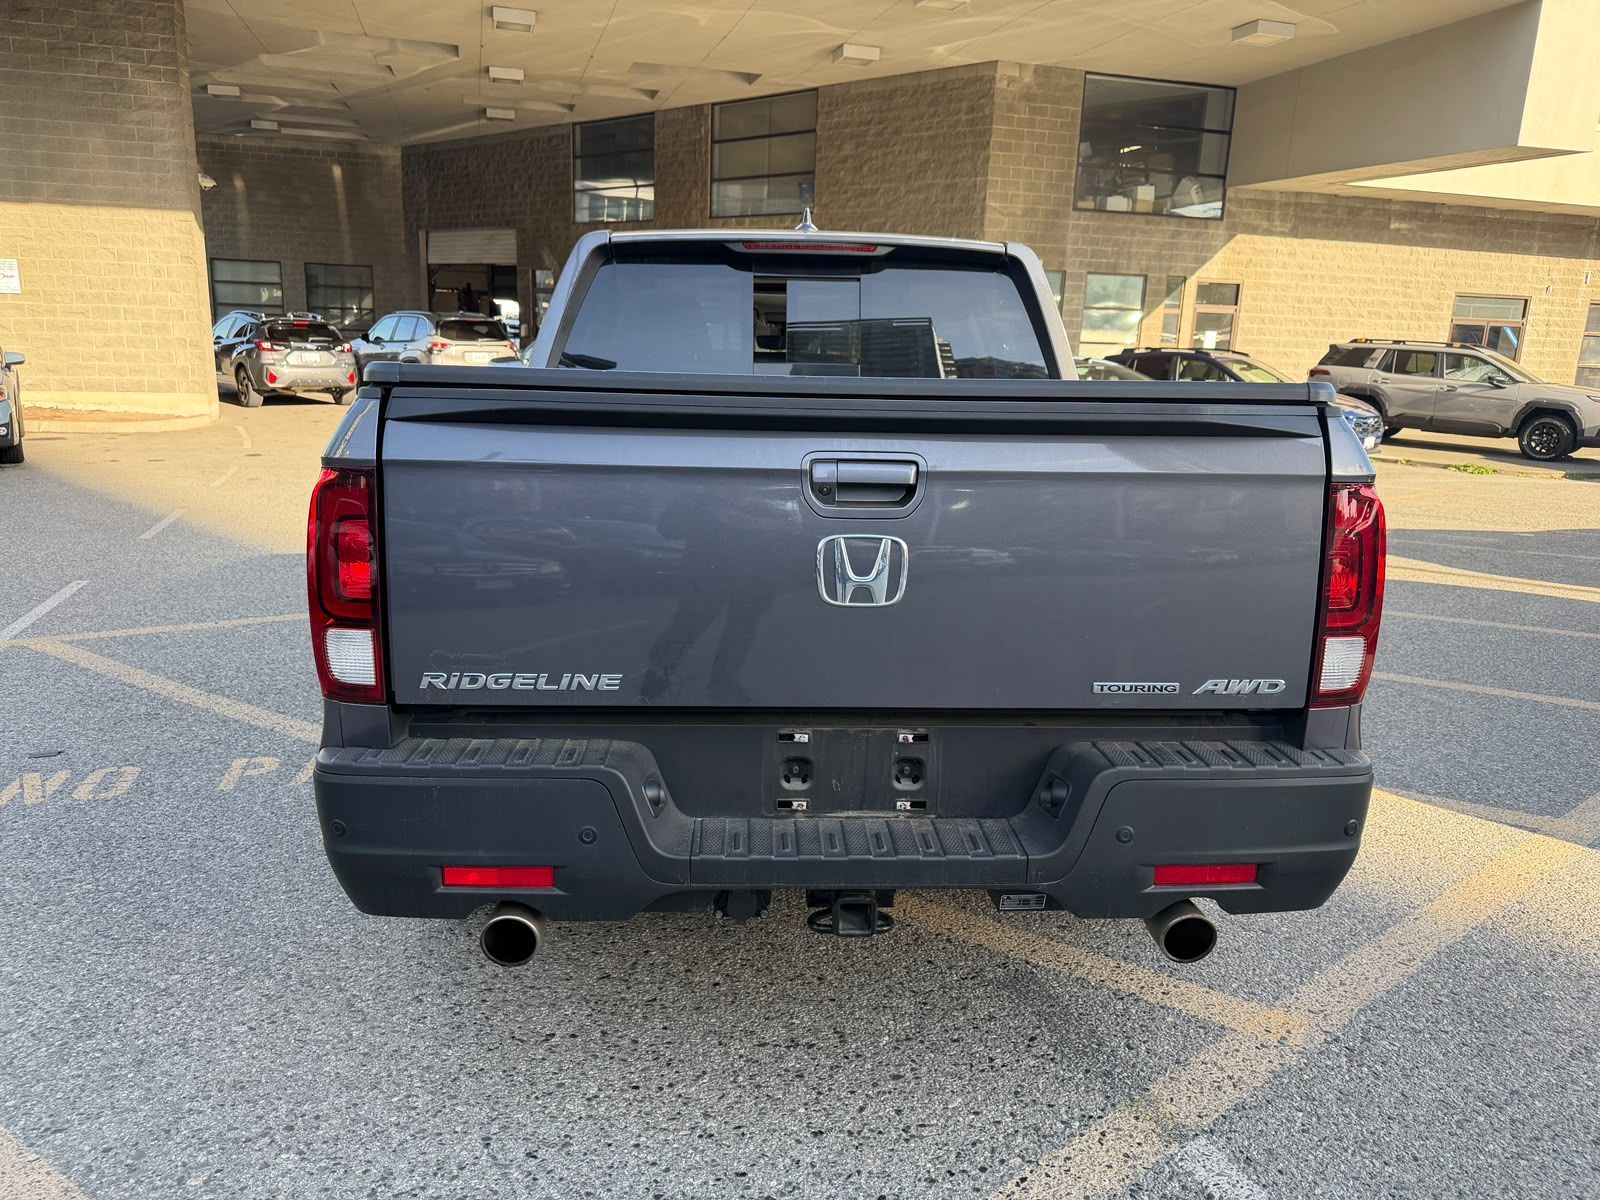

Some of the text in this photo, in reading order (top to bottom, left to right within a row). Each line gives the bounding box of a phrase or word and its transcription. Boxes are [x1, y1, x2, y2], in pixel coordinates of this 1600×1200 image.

[418, 671, 624, 691] RIDGELINE
[1096, 683, 1178, 693] TOURING
[1191, 679, 1287, 695] AWD
[0, 766, 142, 807] NO
